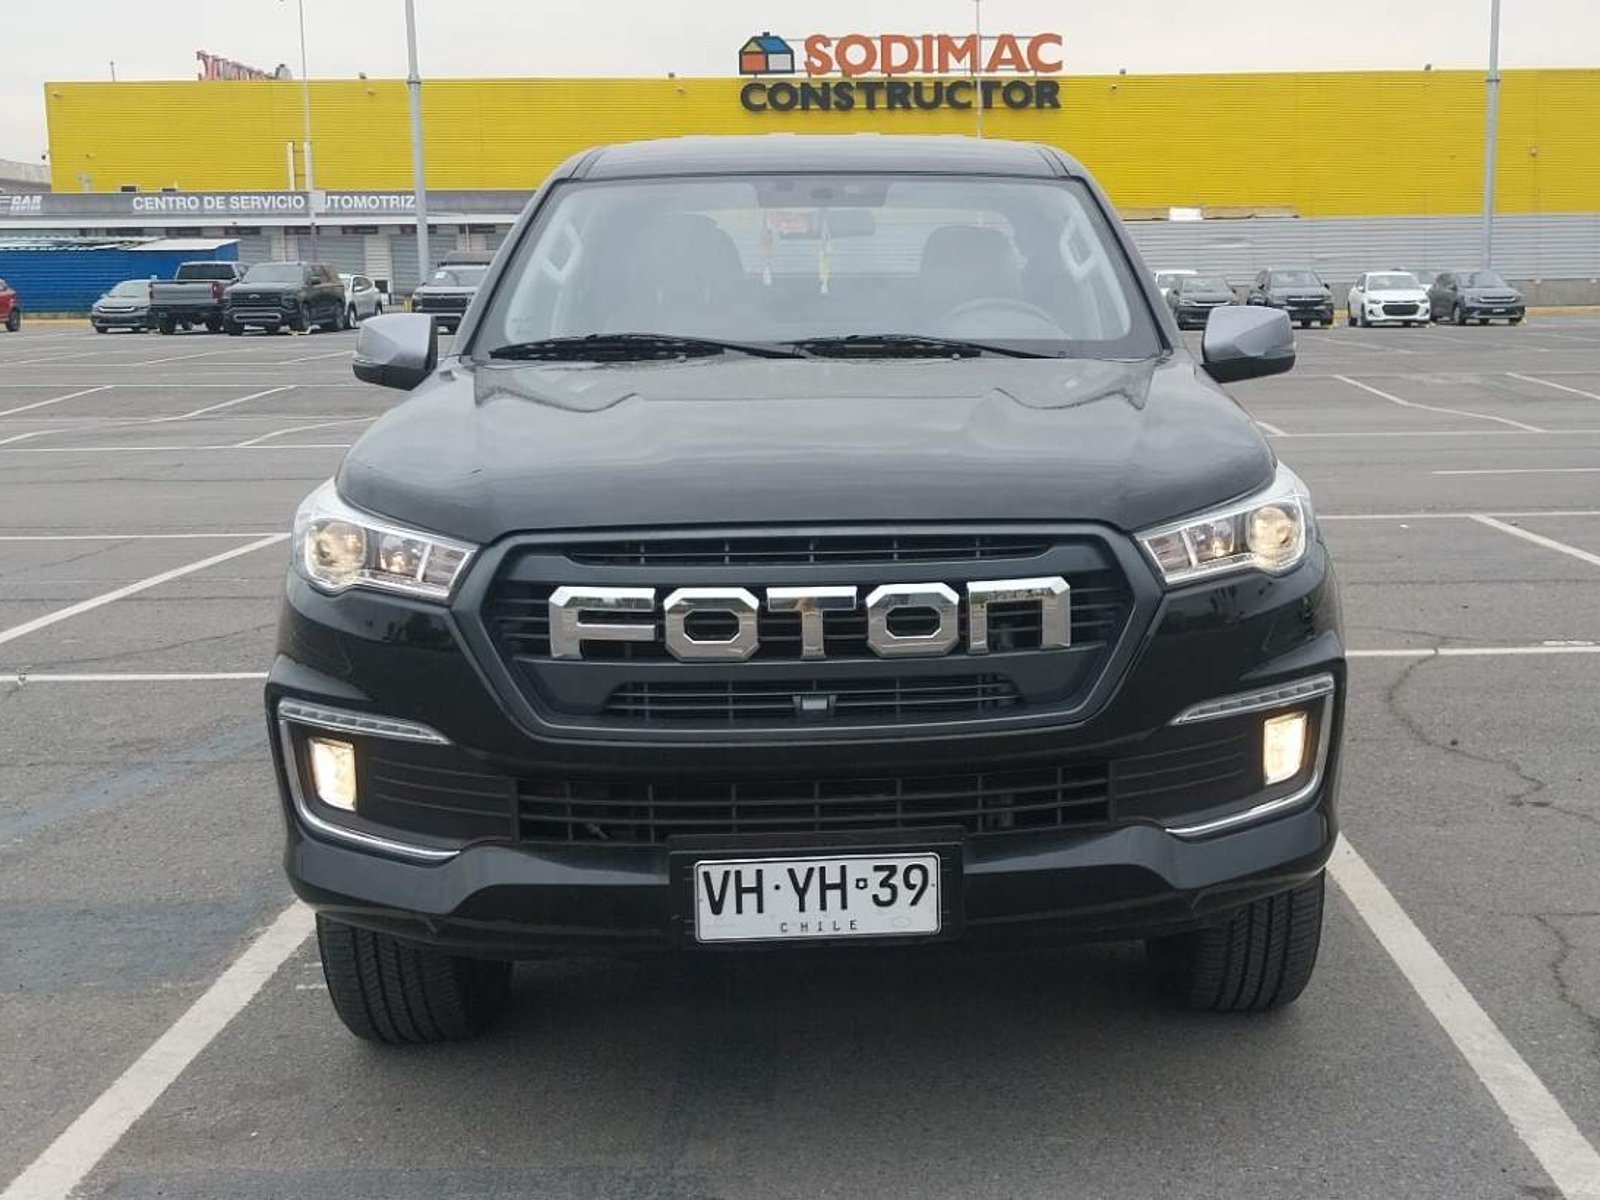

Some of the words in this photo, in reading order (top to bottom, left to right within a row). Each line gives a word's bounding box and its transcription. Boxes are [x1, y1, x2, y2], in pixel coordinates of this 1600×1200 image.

[804, 33, 1063, 75] SODIMAC
[740, 79, 1062, 112] CONSTRUCTOR
[132, 196, 199, 211] CENTRO
[203, 195, 225, 209] DE
[230, 195, 305, 209] SERVICIO
[323, 194, 416, 209] UTOMOTRIZ
[780, 919, 858, 933] CHILE
